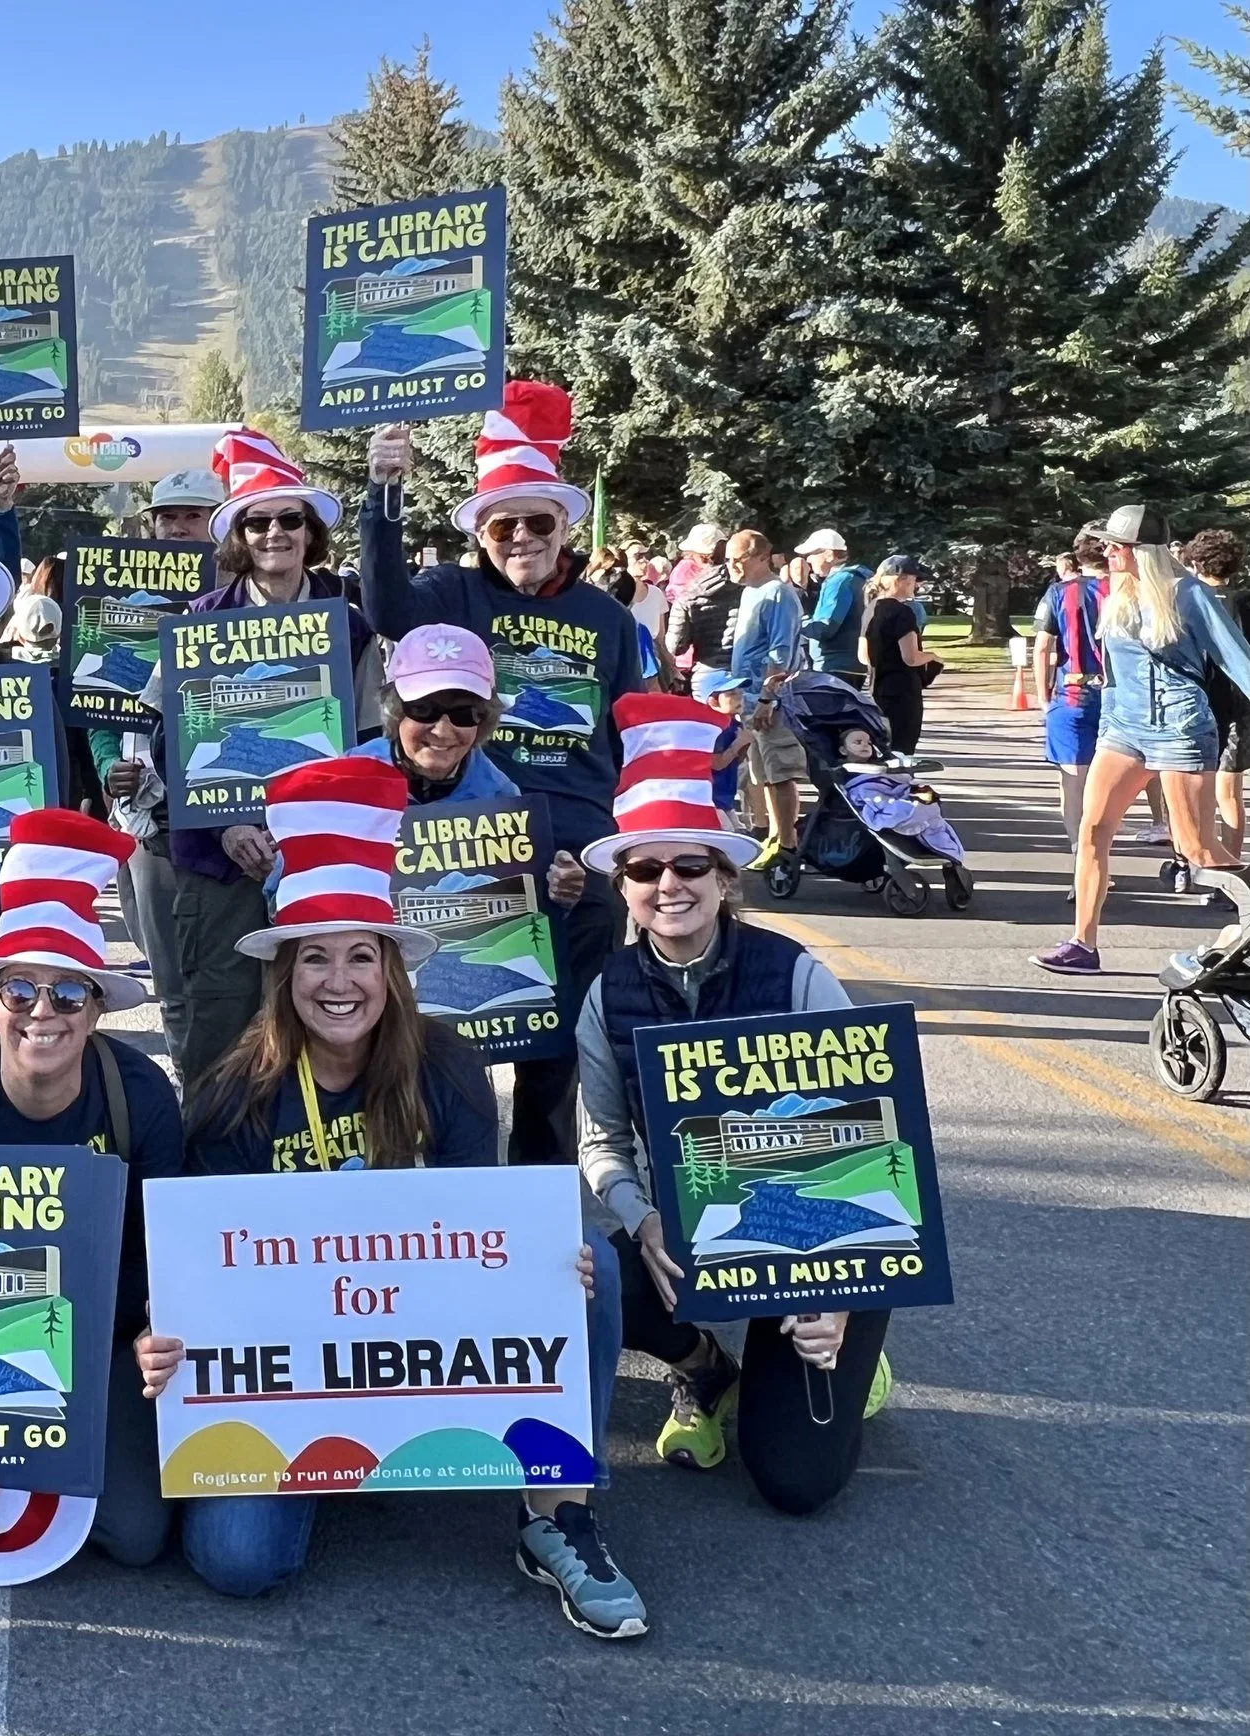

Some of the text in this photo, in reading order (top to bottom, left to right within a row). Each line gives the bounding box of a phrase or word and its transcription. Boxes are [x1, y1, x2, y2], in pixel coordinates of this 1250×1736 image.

[322, 201, 487, 246] THE LIBRARY
[323, 222, 486, 269] IS CALLING
[320, 372, 485, 406] AND I MUST GO
[41, 406, 65, 419] GO
[76, 547, 203, 571] THE LIBRARY
[76, 564, 200, 592] IS CALLING
[172, 611, 329, 646] THE LIBRARY
[509, 628, 597, 660] CALLING
[519, 615, 598, 645] LIBRARY
[176, 632, 330, 669] IS CALLING
[70, 694, 104, 709] AND
[109, 697, 114, 711] I
[493, 729, 515, 742] ND
[532, 734, 578, 749] MUST
[186, 788, 229, 805] AND
[235, 787, 241, 802] I
[413, 810, 528, 845] LIBRARY
[395, 835, 533, 874] CALLING
[457, 1011, 558, 1041] MUST GO
[657, 1024, 888, 1070] THE LIBRARY
[665, 1052, 893, 1102] IS CALLING
[273, 1130, 314, 1155] THE
[729, 1131, 805, 1151] LIBRARY
[272, 1151, 297, 1172] IS
[220, 1221, 508, 1269] I'm running
[695, 1255, 923, 1290] AND I MUST GO
[331, 1276, 400, 1316] for
[774, 1289, 824, 1299] COUNTY
[185, 1337, 568, 1395] THE LIBRARY
[24, 1425, 66, 1448] GO
[193, 1463, 562, 1487] Register to run and donate at oldbills.org
